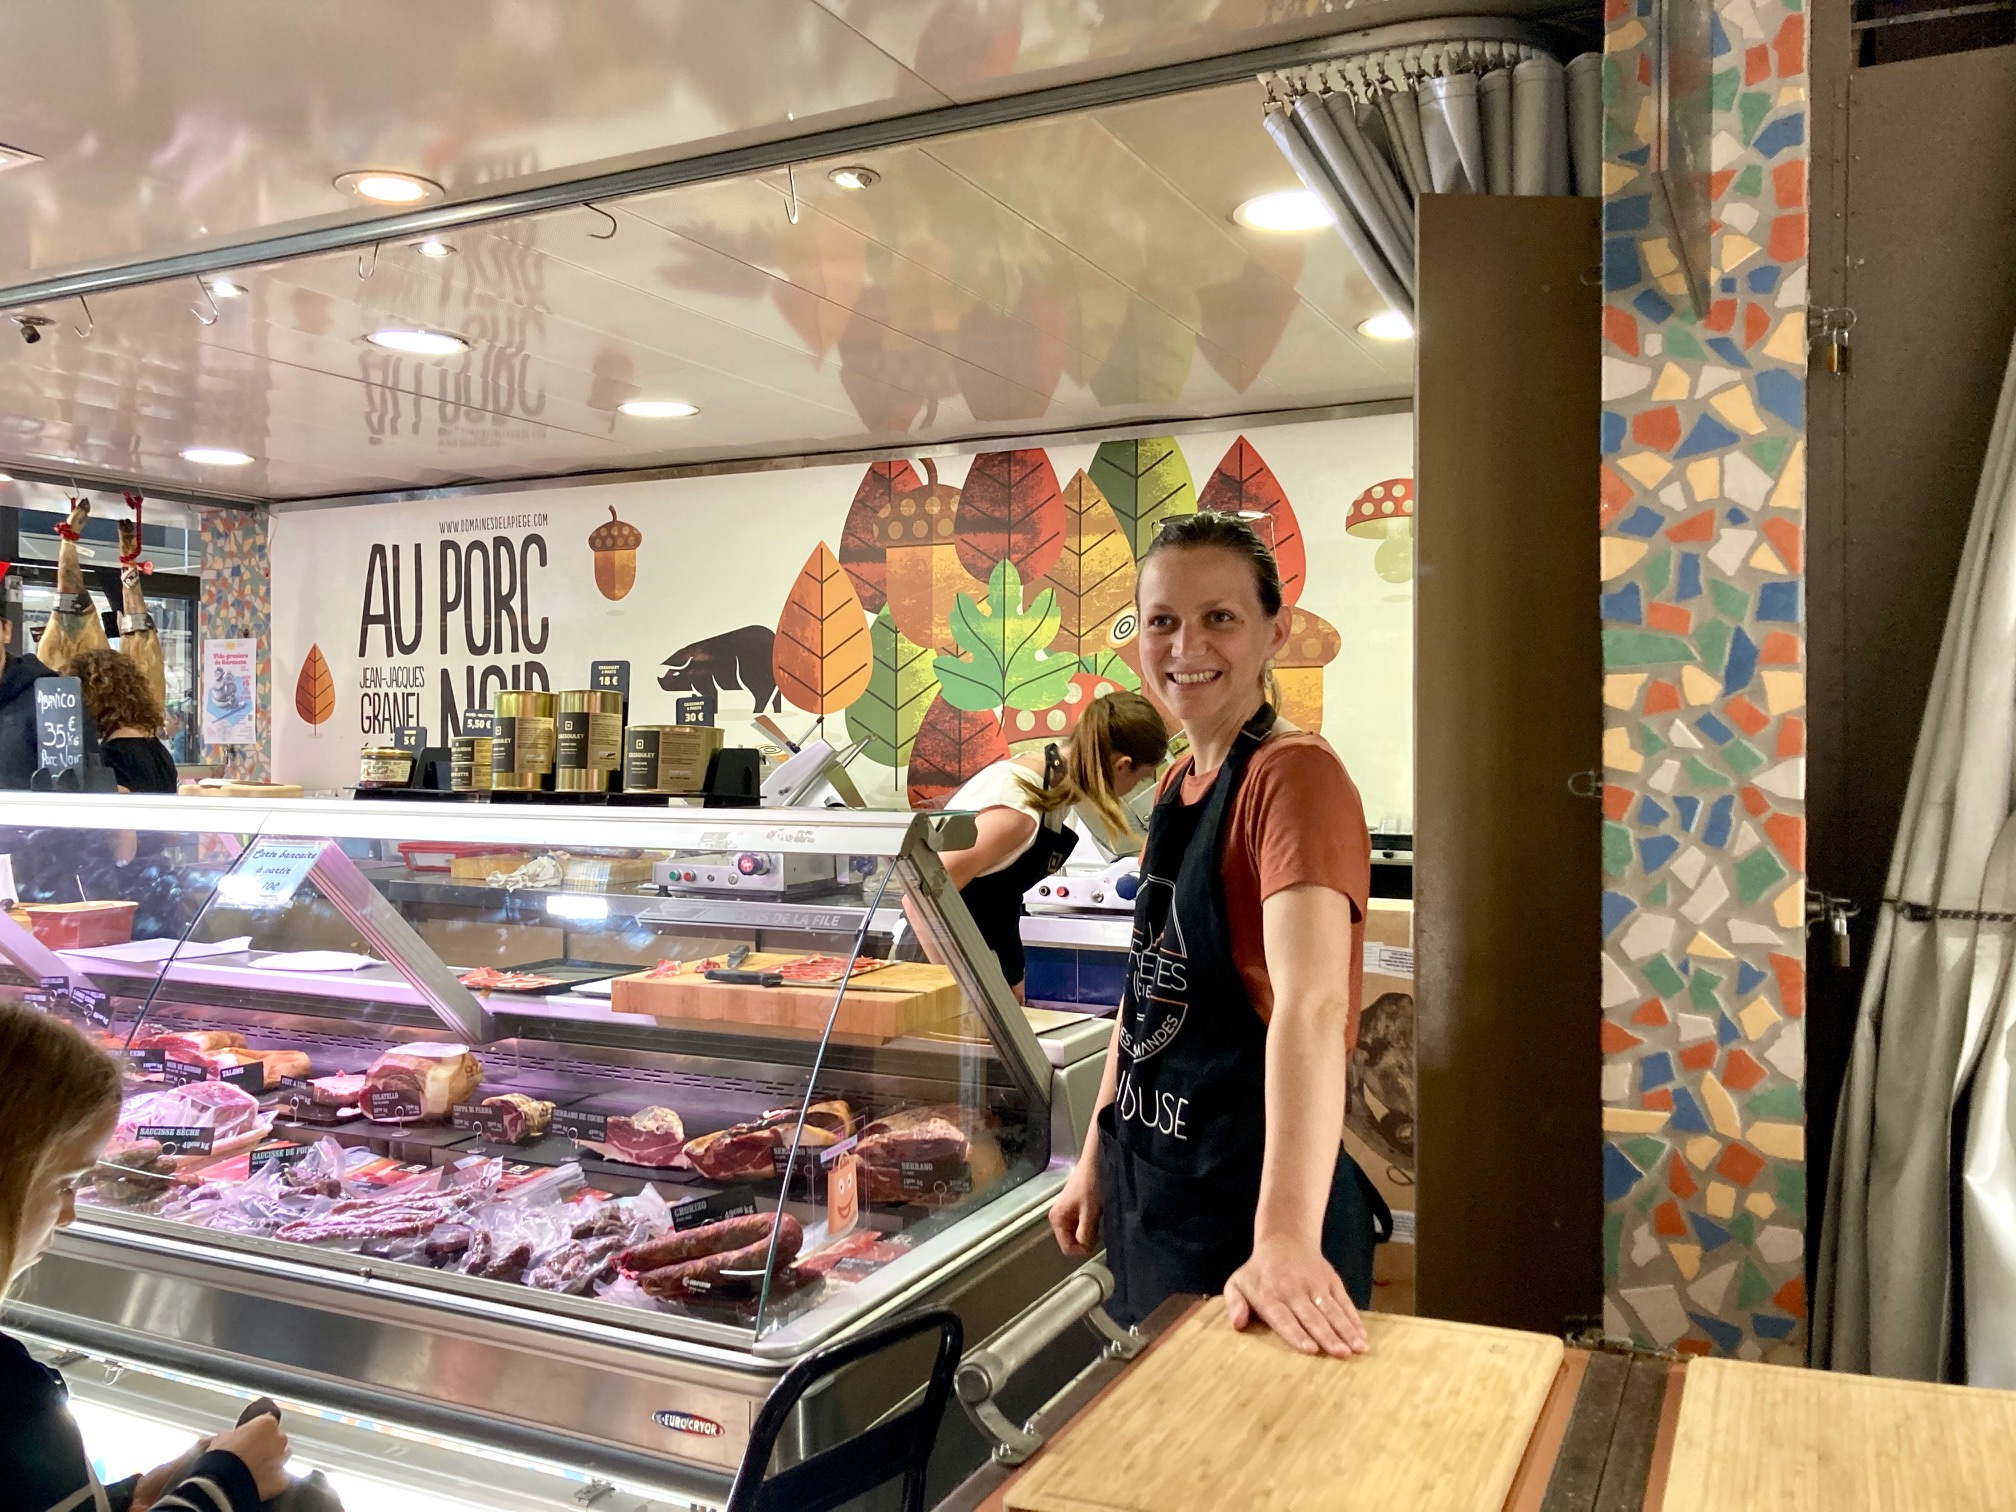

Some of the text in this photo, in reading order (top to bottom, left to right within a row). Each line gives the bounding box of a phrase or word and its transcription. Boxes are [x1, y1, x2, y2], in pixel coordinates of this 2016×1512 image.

[359, 533, 549, 658] AU PORC
[359, 666, 425, 689] JEAN-JACQUES
[599, 676, 618, 685] 18 €
[685, 712, 705, 722] 30 €
[467, 719, 492, 729] 5,50 €
[43, 716, 76, 748] 35 €
[404, 736, 416, 745] 5 €
[772, 912, 791, 924] DE
[792, 913, 810, 926] LA
[811, 914, 841, 927] FILE
[140, 1128, 175, 1136] SAUCISSE
[252, 1150, 284, 1160] SAUCISSE
[901, 1162, 933, 1170] SERRANO
[674, 1201, 707, 1217] CHORIZO
